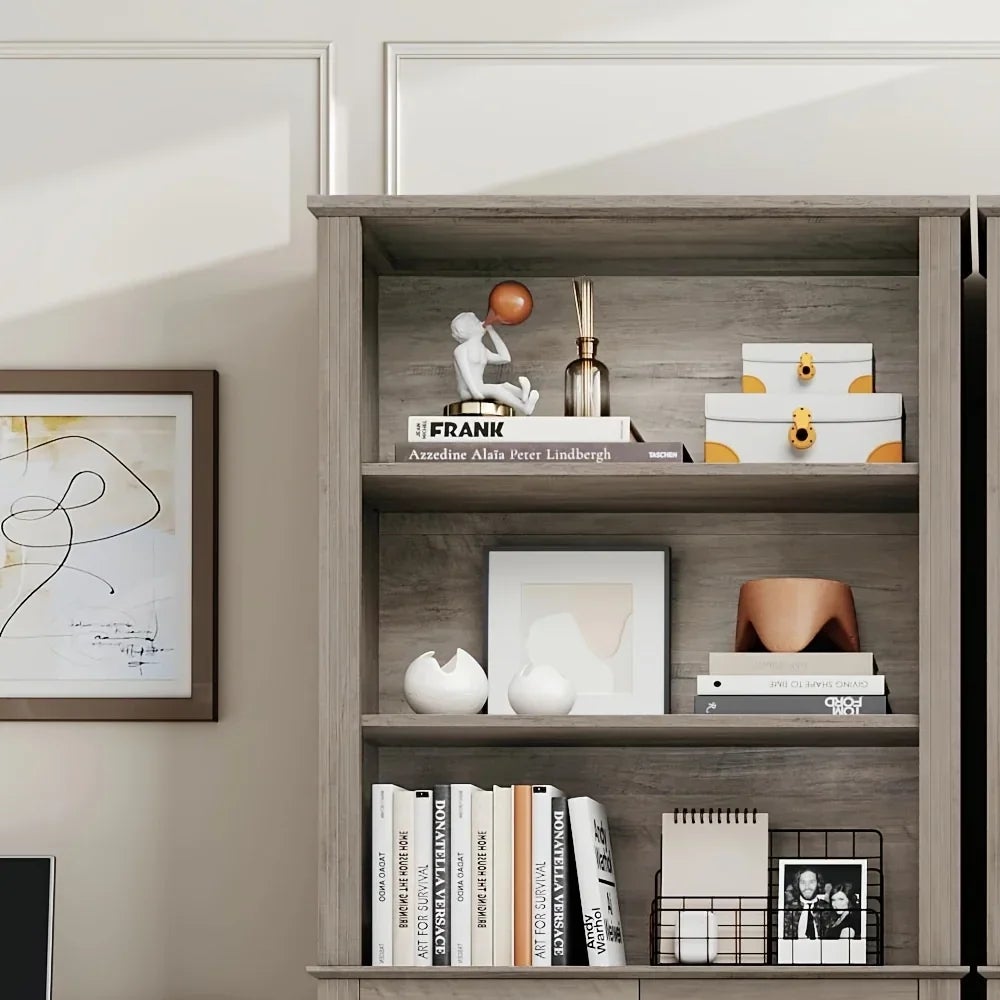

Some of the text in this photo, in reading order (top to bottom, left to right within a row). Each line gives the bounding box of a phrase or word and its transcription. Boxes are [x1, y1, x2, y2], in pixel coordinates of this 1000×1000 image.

[430, 422, 504, 437] FRANK
[408, 448, 467, 460] Azzedine
[510, 449, 541, 460] Peter
[546, 448, 612, 463] Lindbergh
[648, 451, 678, 459] TASCHEN
[824, 696, 863, 707] FORD
[832, 706, 861, 715] TOM
[434, 800, 446, 955] DONATELLA VERSACE
[553, 810, 564, 956] DONATELLA VERSACE
[417, 864, 429, 959] ART FOR SURVIVAL
[535, 861, 546, 959] ART FOR SURVIVAL
[584, 914, 596, 949] Andy
[592, 907, 606, 955] Warhol
